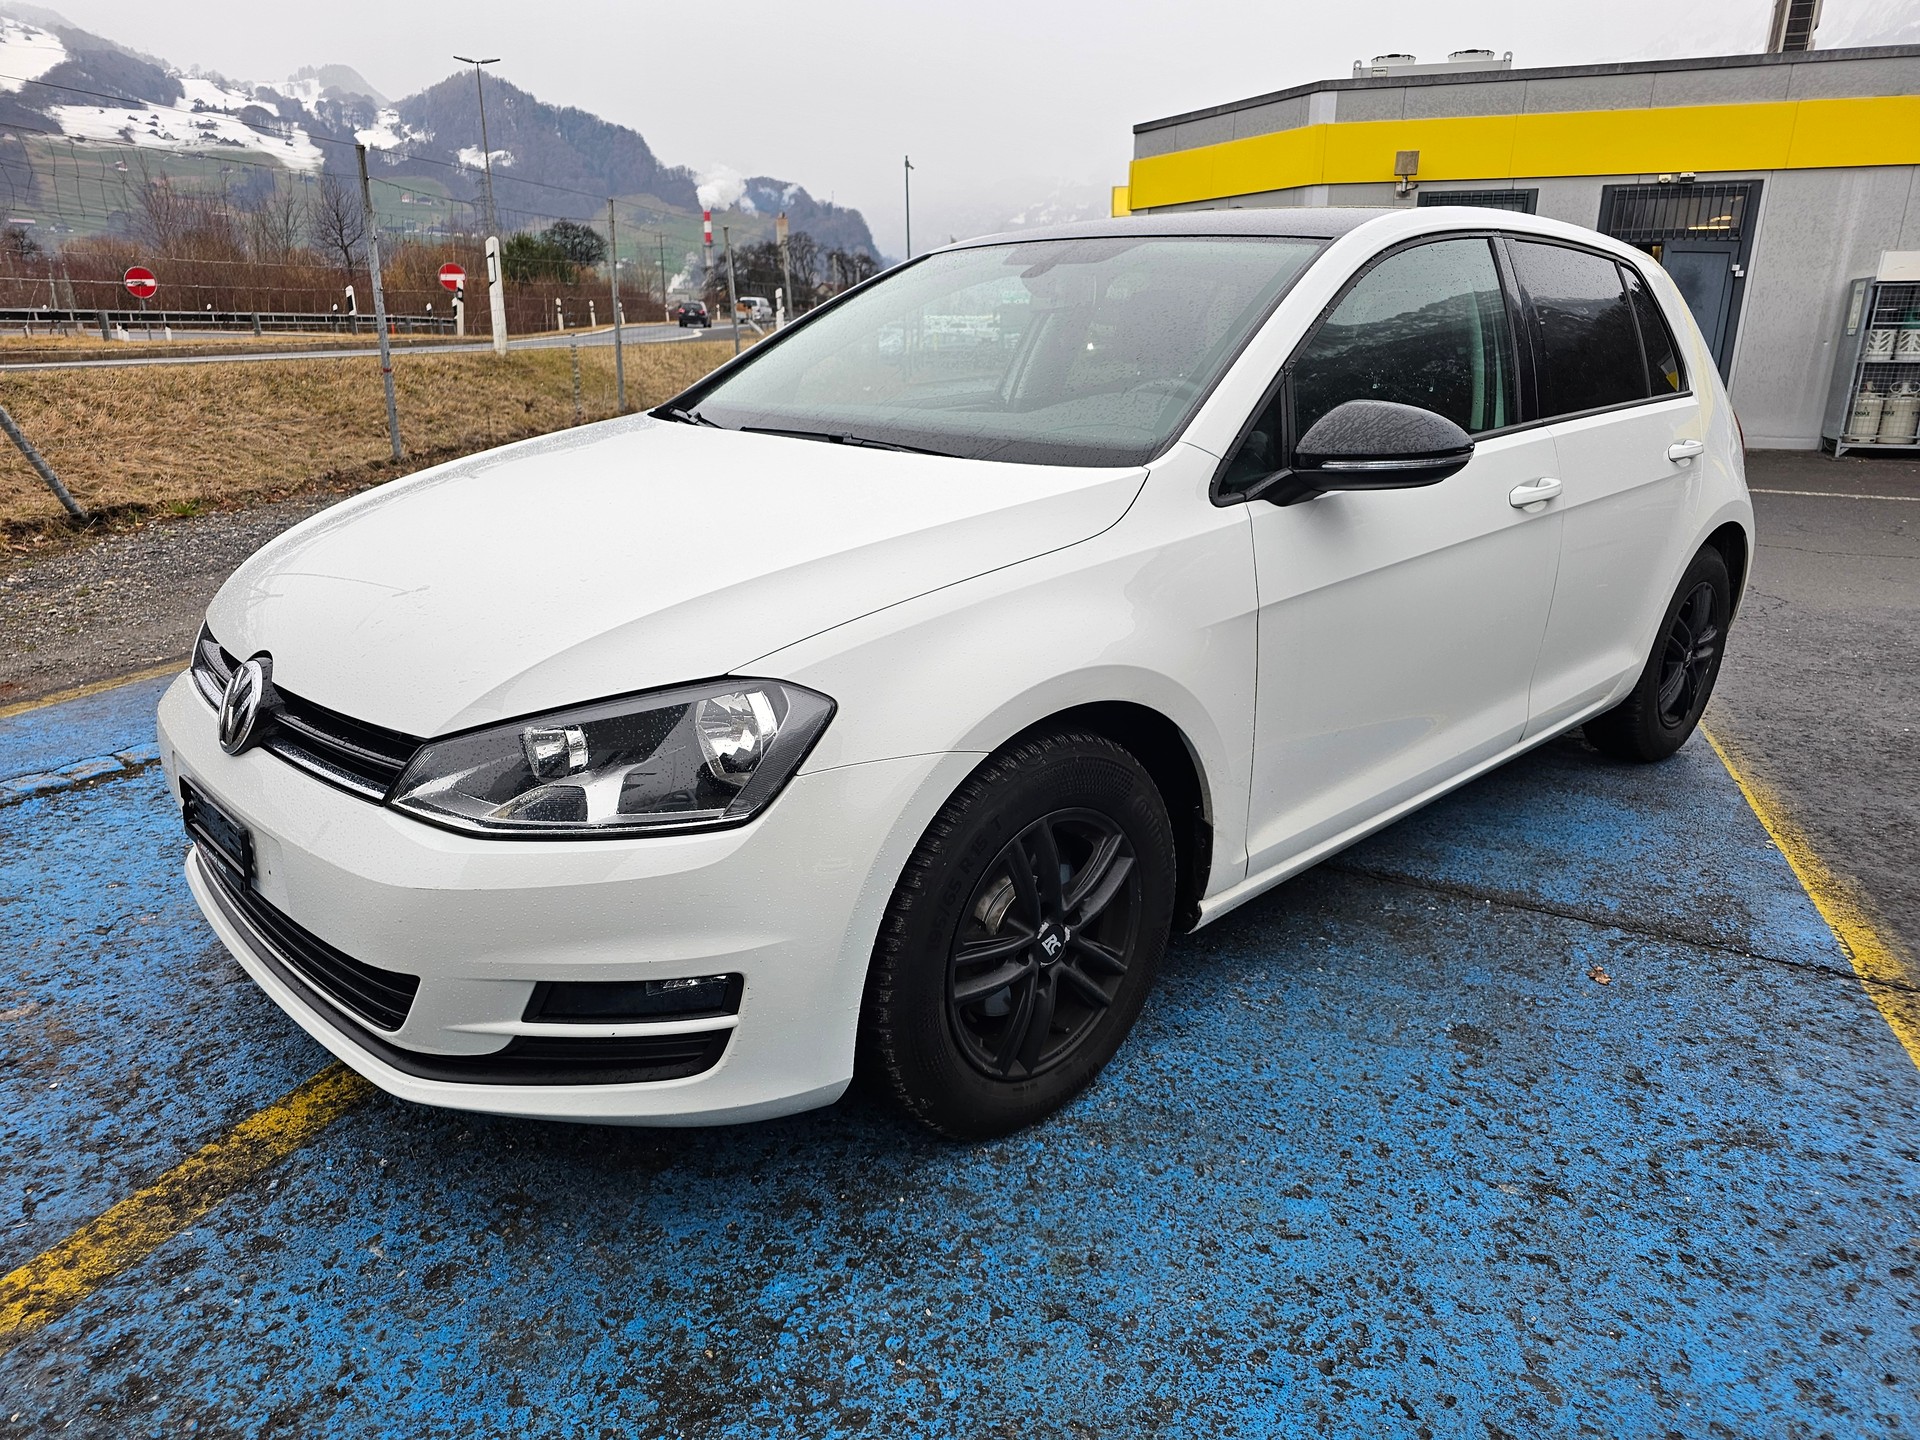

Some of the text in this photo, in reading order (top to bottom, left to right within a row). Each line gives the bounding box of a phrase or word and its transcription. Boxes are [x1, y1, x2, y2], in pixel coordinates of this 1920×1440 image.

[927, 876, 963, 952] 195/65
[959, 856, 975, 875] R
[970, 833, 989, 857] 15
